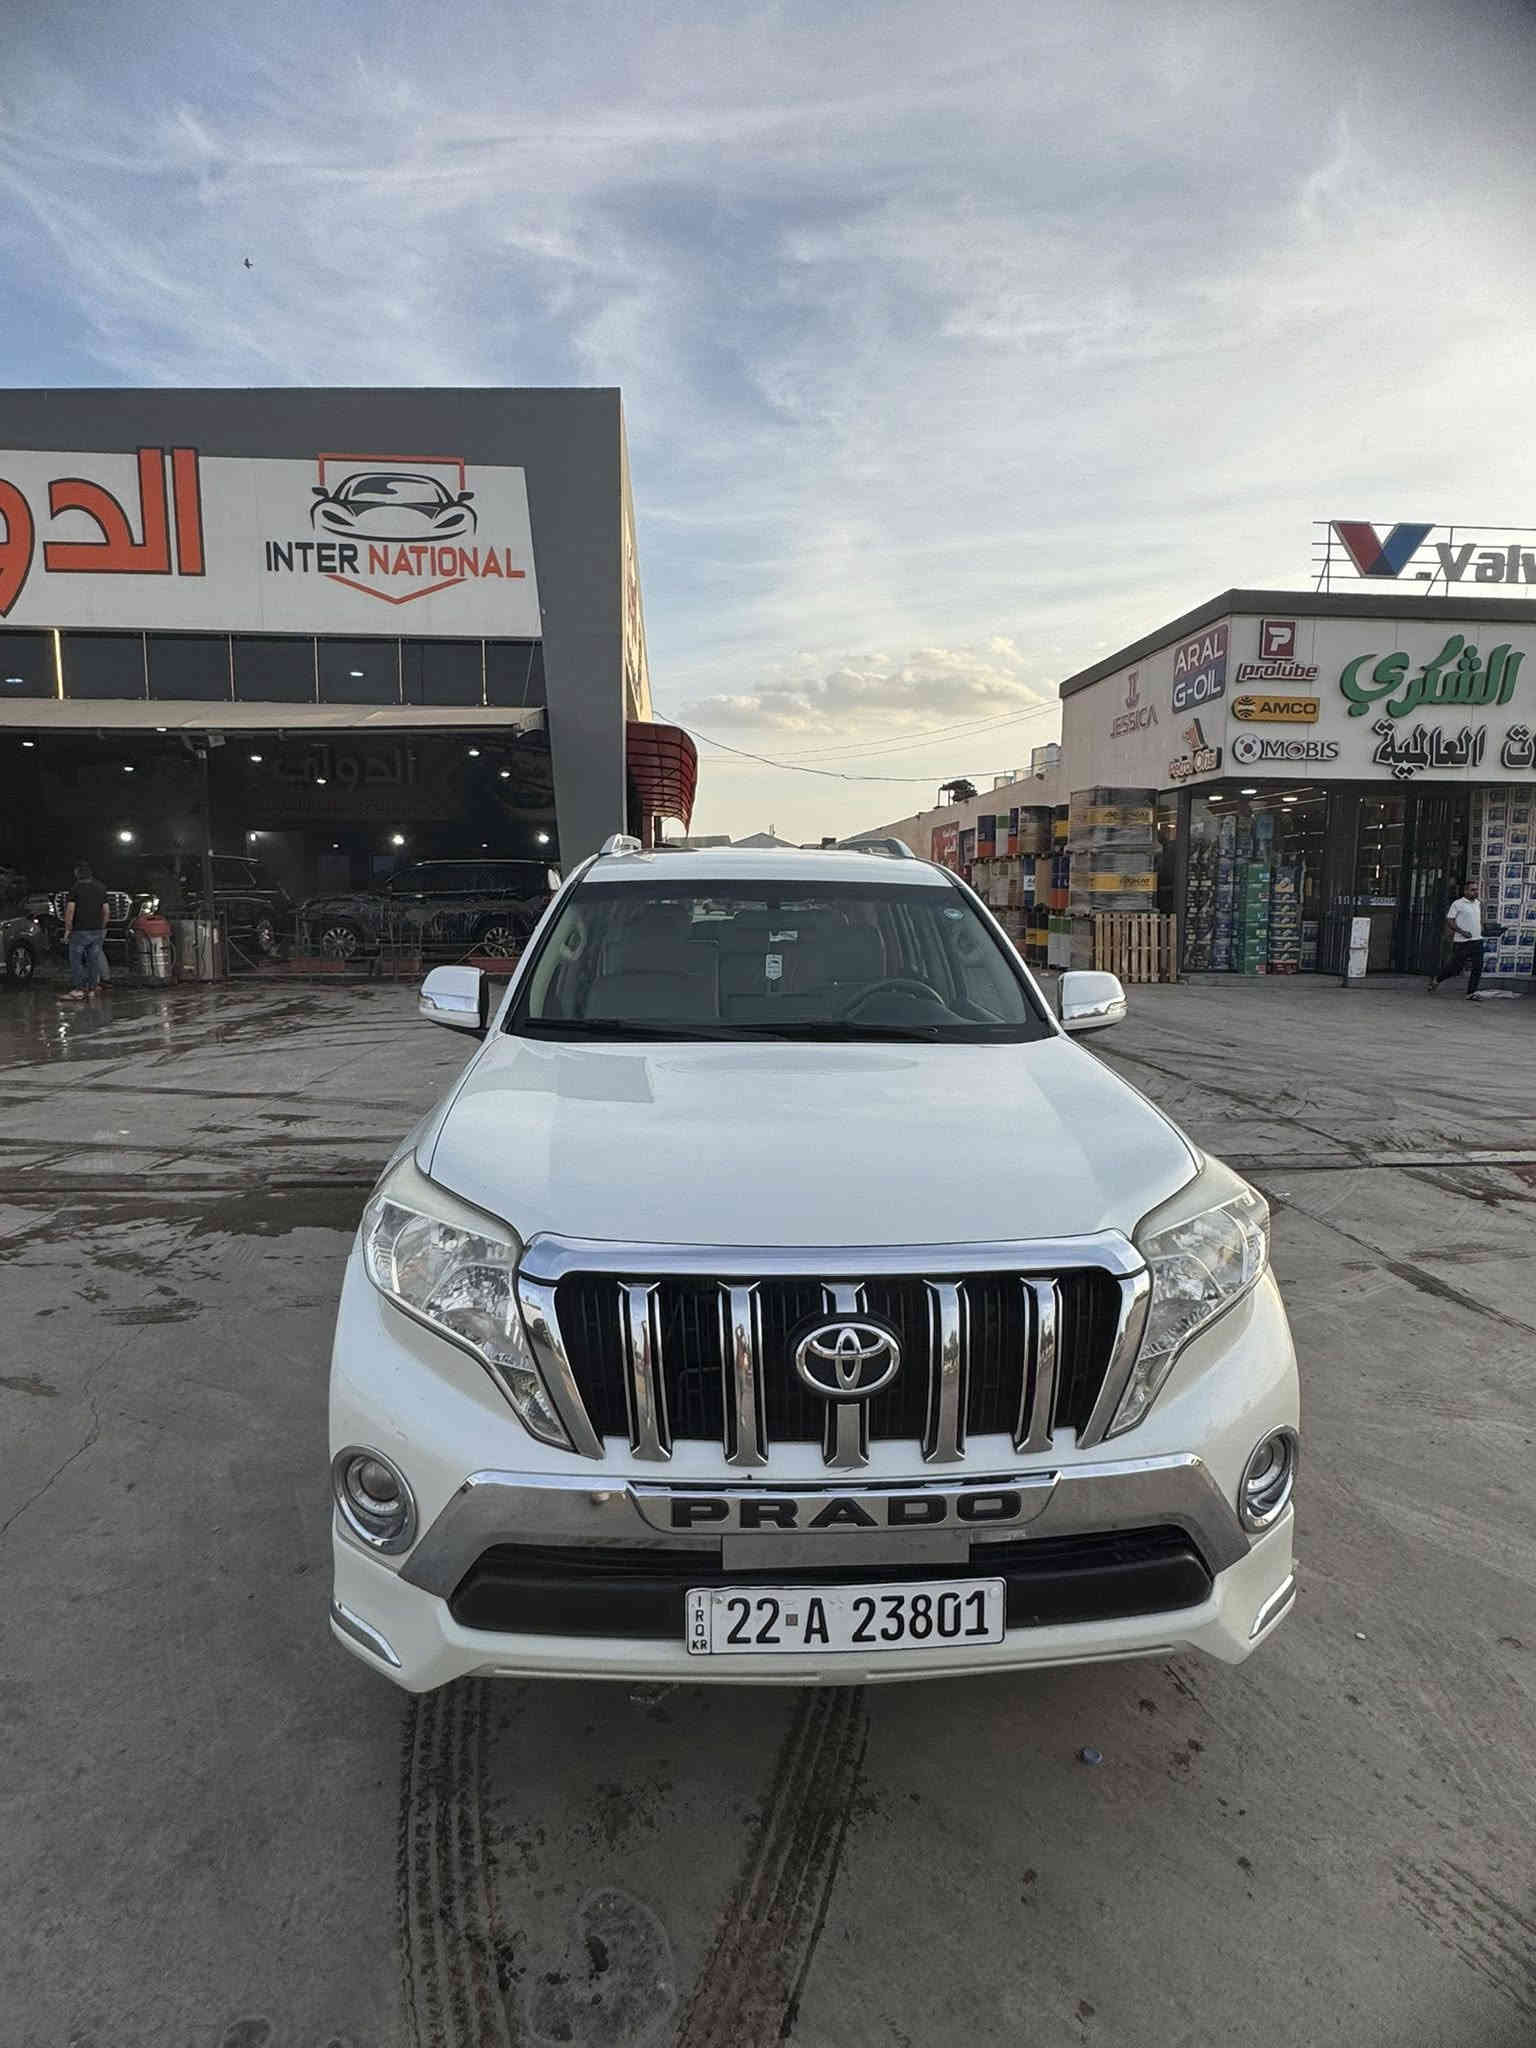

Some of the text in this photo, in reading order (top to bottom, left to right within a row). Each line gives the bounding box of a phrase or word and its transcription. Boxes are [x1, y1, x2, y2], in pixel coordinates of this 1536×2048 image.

[265, 541, 526, 578] INTER NATIONAL
[1175, 634, 1224, 676] ARAL
[1174, 671, 1221, 707] G-OIL
[1340, 634, 1526, 718] الشكري
[1260, 702, 1316, 714] AMCO
[1264, 739, 1340, 760] MOBIS
[1372, 719, 1488, 779] العالمية
[670, 1490, 1022, 1529] PRADO
[727, 1590, 989, 1645] 22 A 23801
[692, 1640, 707, 1650] KR
